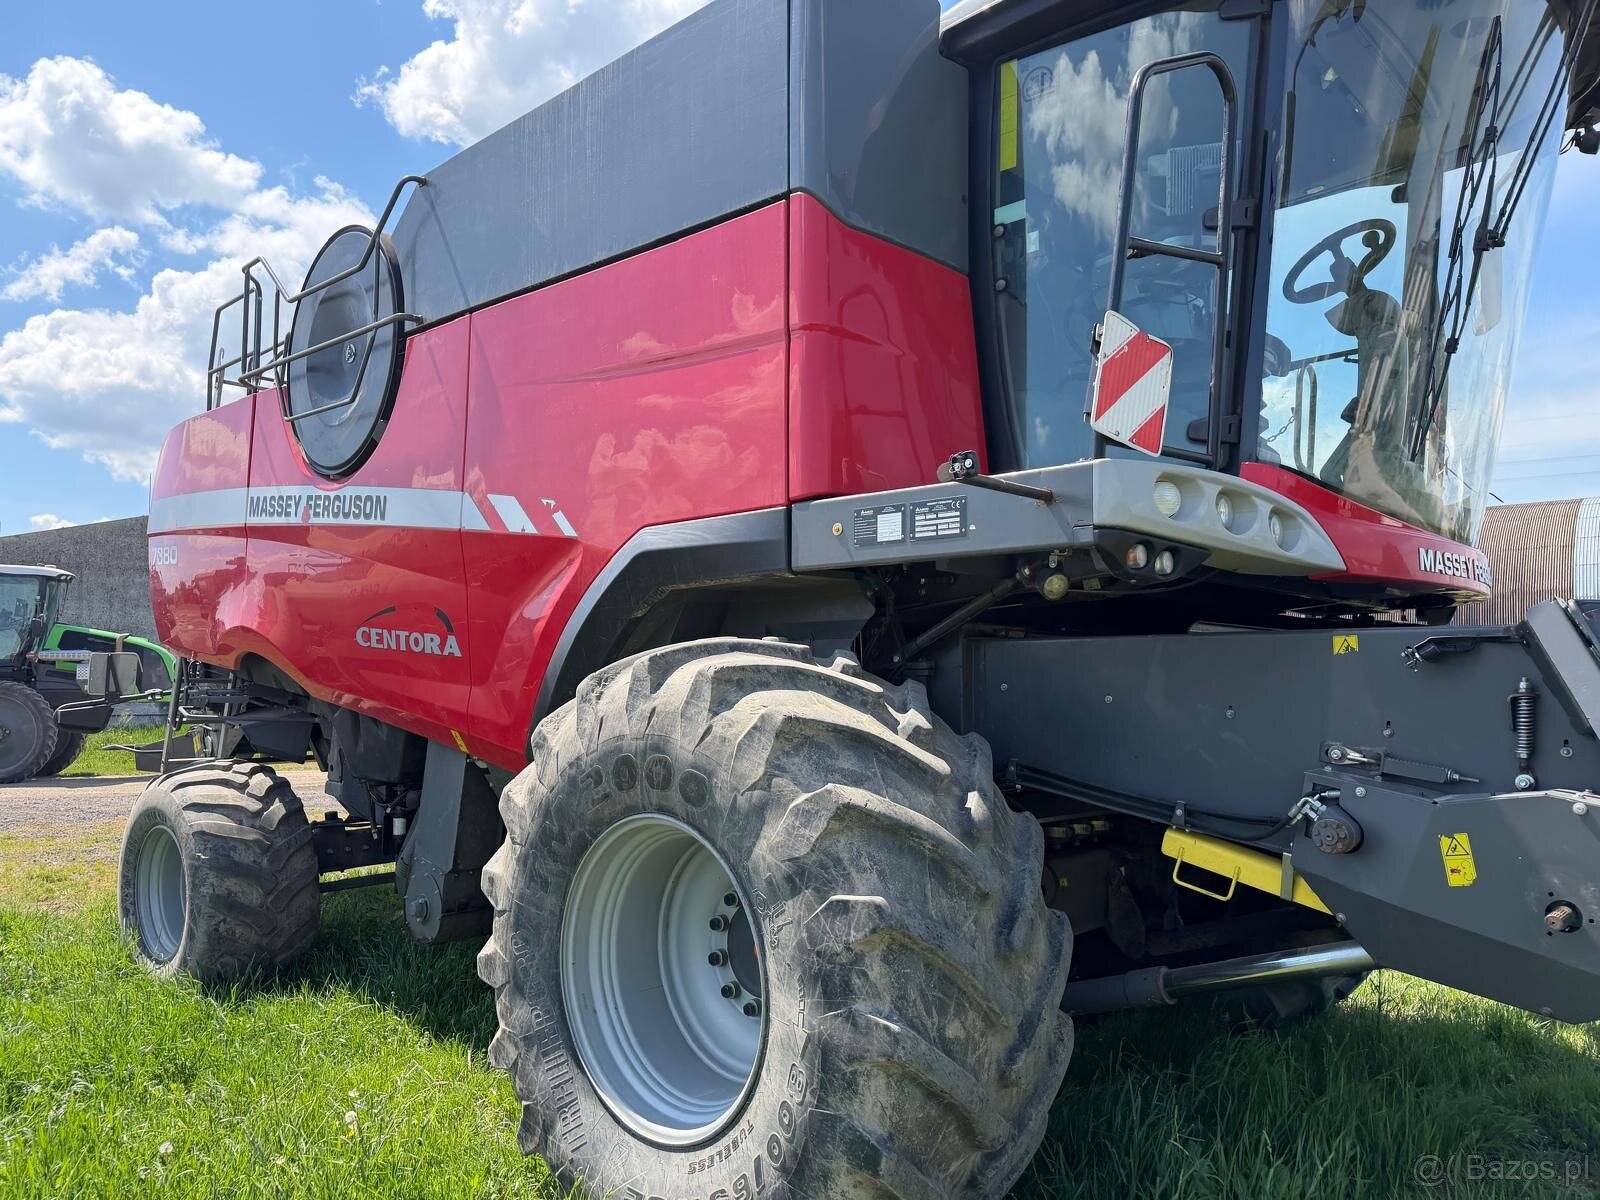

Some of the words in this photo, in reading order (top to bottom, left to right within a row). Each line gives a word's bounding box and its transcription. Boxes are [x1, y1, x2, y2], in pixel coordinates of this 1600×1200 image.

[249, 495, 302, 518] MASSEY
[305, 495, 387, 521] FERGUSON
[1418, 547, 1473, 579] MASSEY
[355, 626, 462, 657] CENTORA
[687, 1119, 755, 1175] TUBELESS
